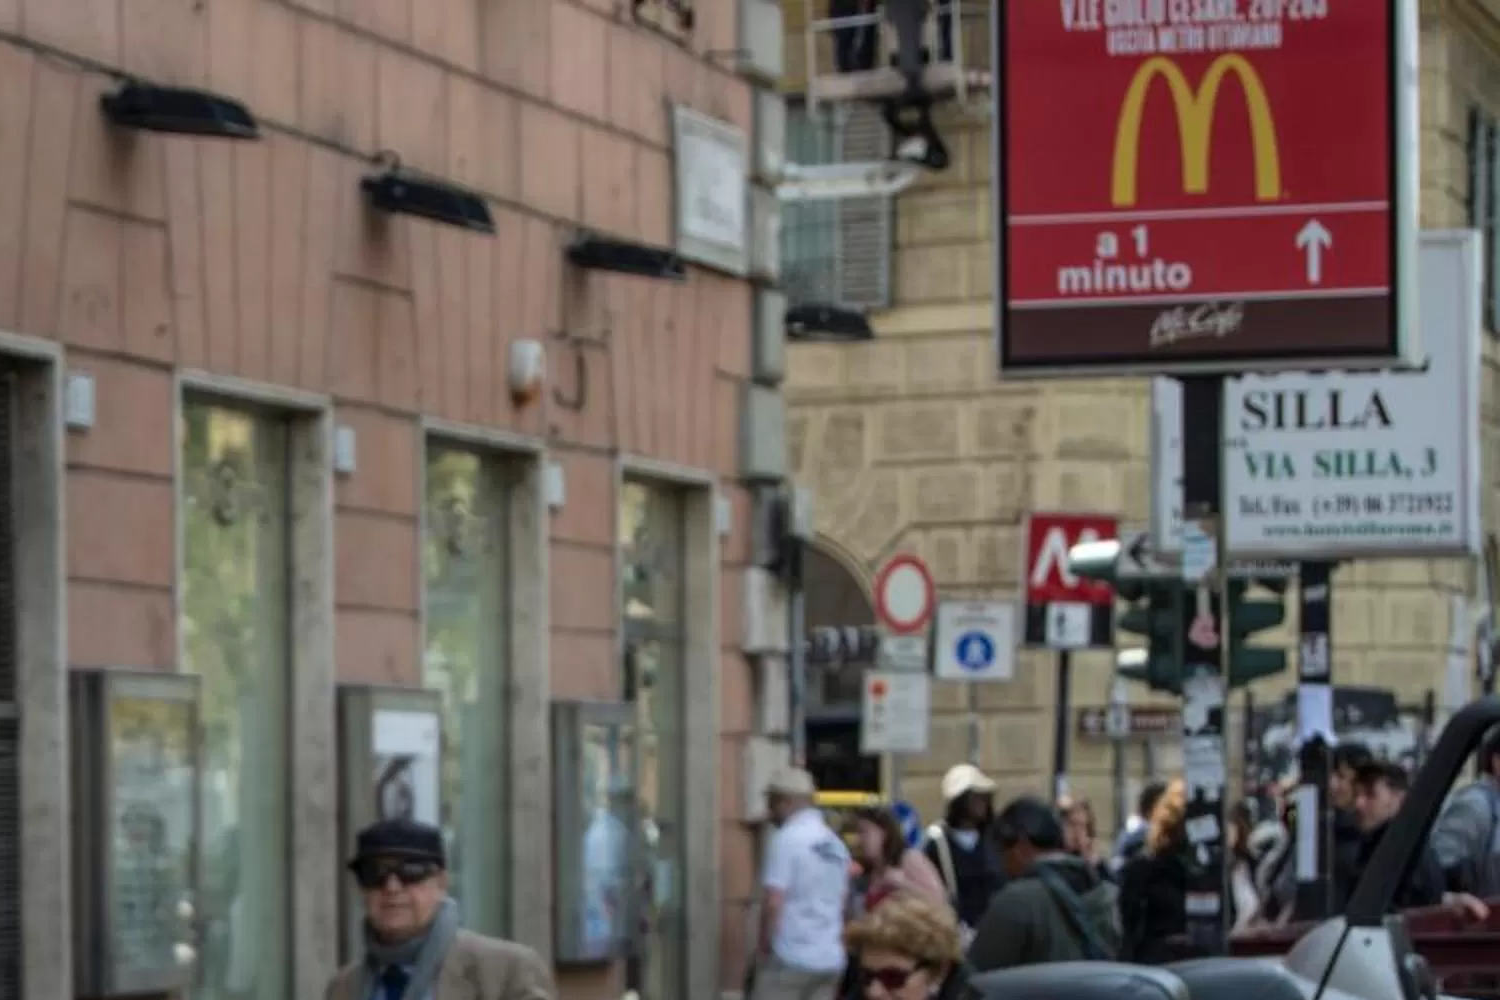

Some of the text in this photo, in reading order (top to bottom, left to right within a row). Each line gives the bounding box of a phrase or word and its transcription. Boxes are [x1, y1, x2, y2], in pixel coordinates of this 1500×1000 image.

[1096, 224, 1148, 258] a 1
[1057, 258, 1192, 294] minuto
[1241, 389, 1394, 430] SILLA
[1244, 447, 1439, 482] VIA SILLA, 3
